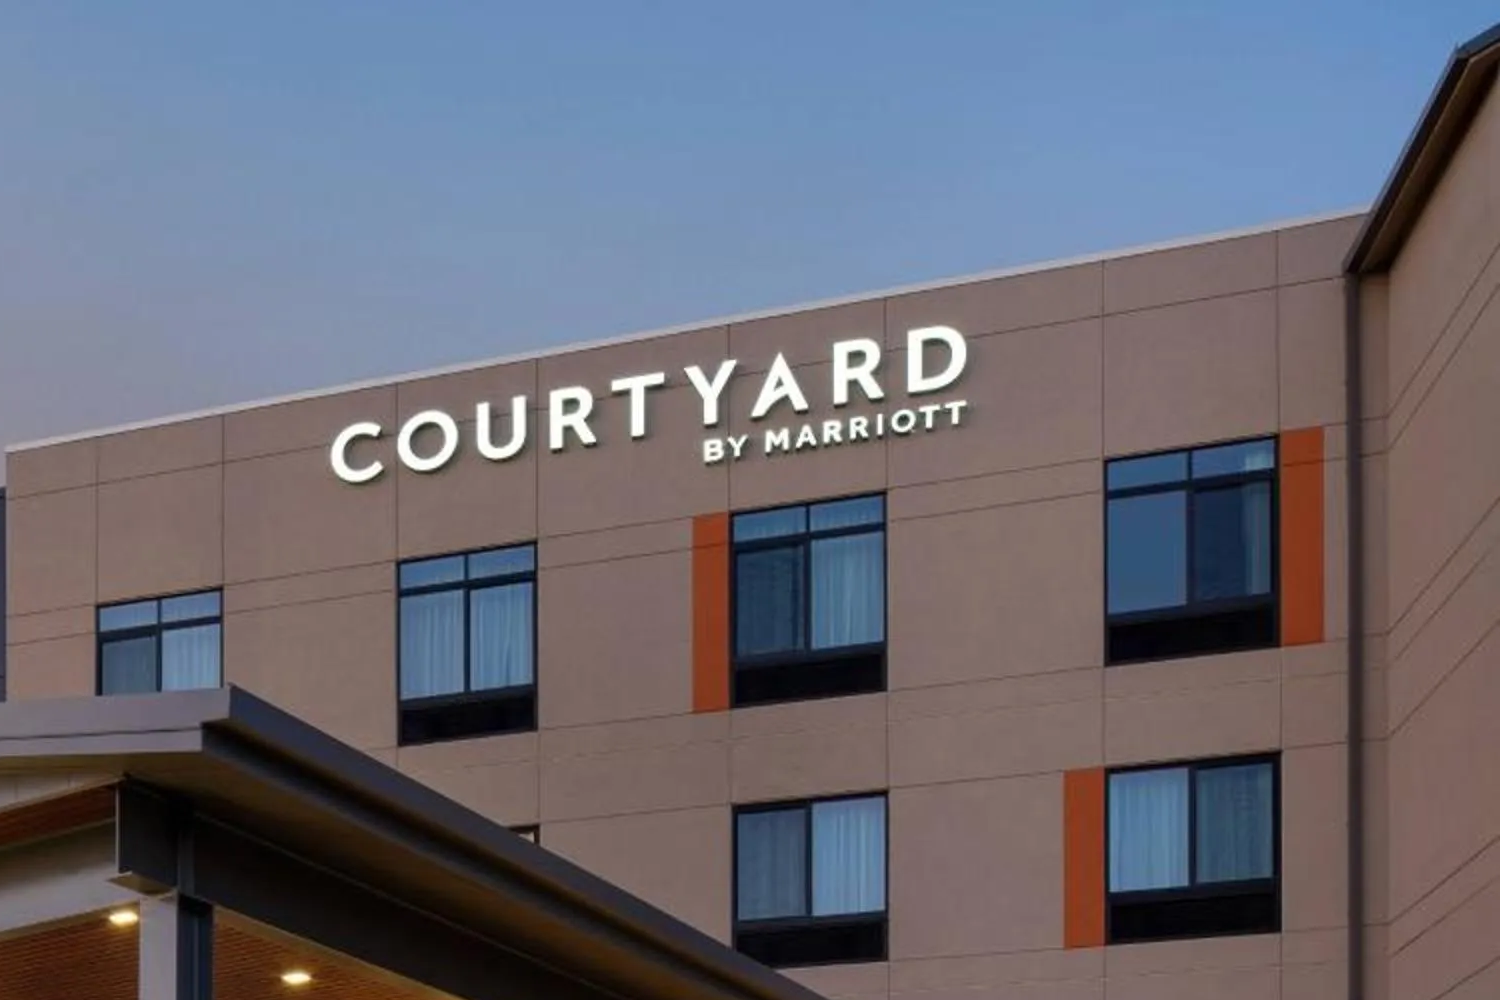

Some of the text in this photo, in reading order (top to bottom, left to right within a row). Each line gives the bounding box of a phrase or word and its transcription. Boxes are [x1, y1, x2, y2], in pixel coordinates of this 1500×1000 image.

[330, 325, 968, 483] COURTYARD
[703, 399, 968, 463] BY MARRIOTT
